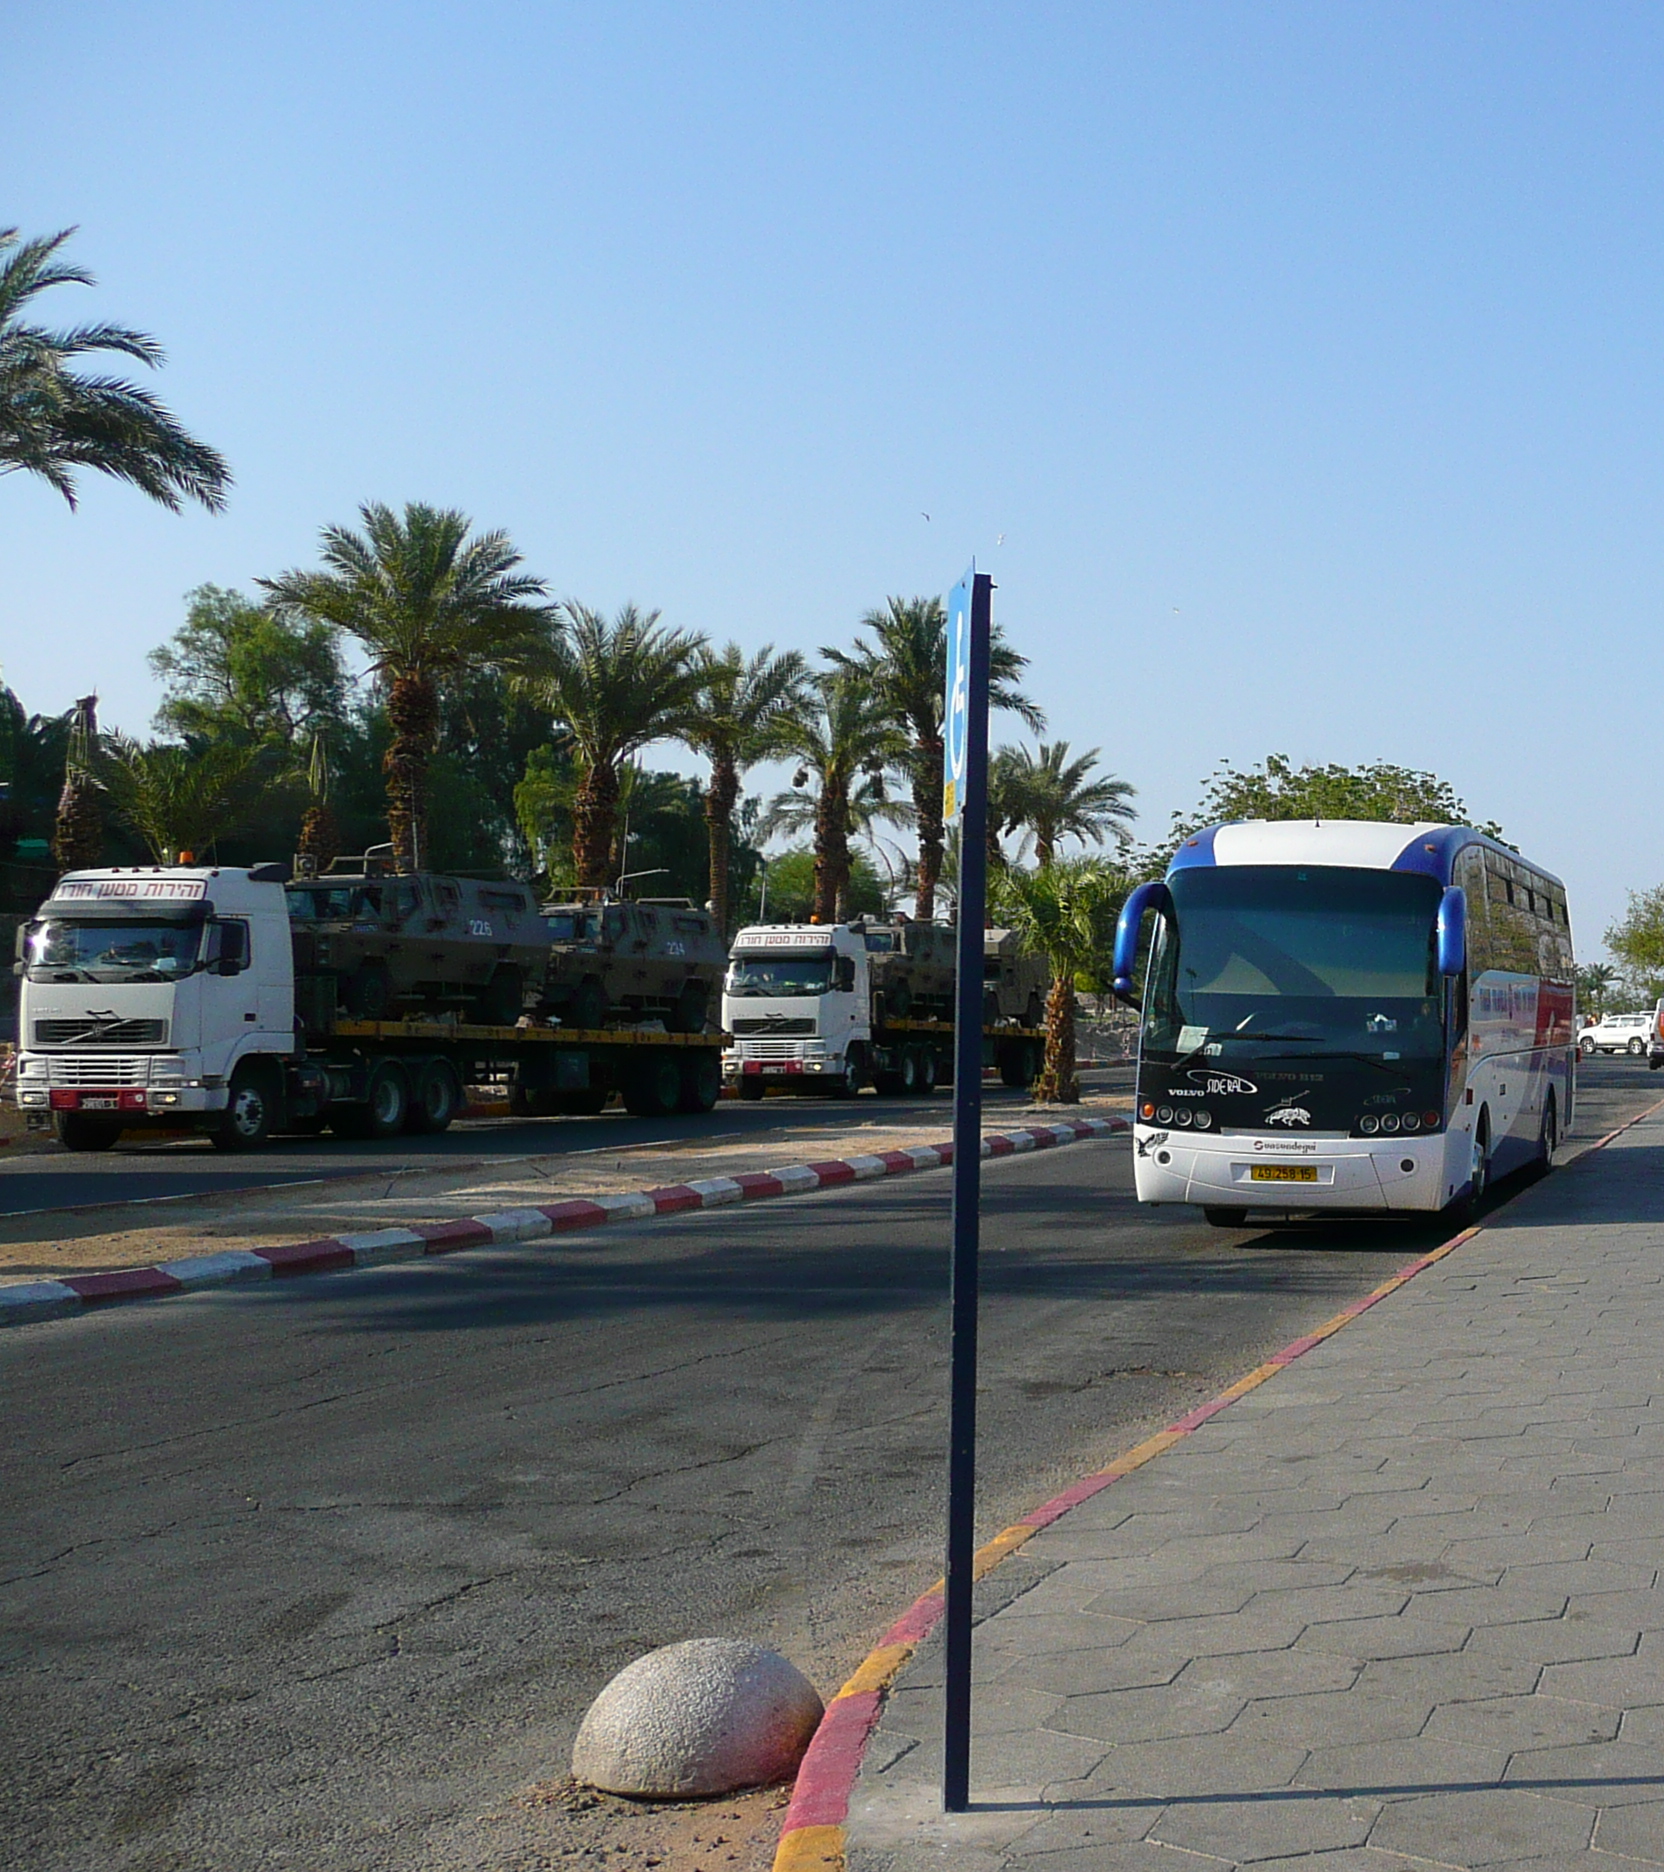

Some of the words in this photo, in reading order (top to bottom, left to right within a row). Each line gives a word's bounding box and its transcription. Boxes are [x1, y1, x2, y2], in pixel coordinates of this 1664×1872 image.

[97, 883, 138, 899] מטען
[144, 883, 202, 898] זהירות
[470, 919, 493, 937] 226
[1168, 1089, 1205, 1097] VOLVO
